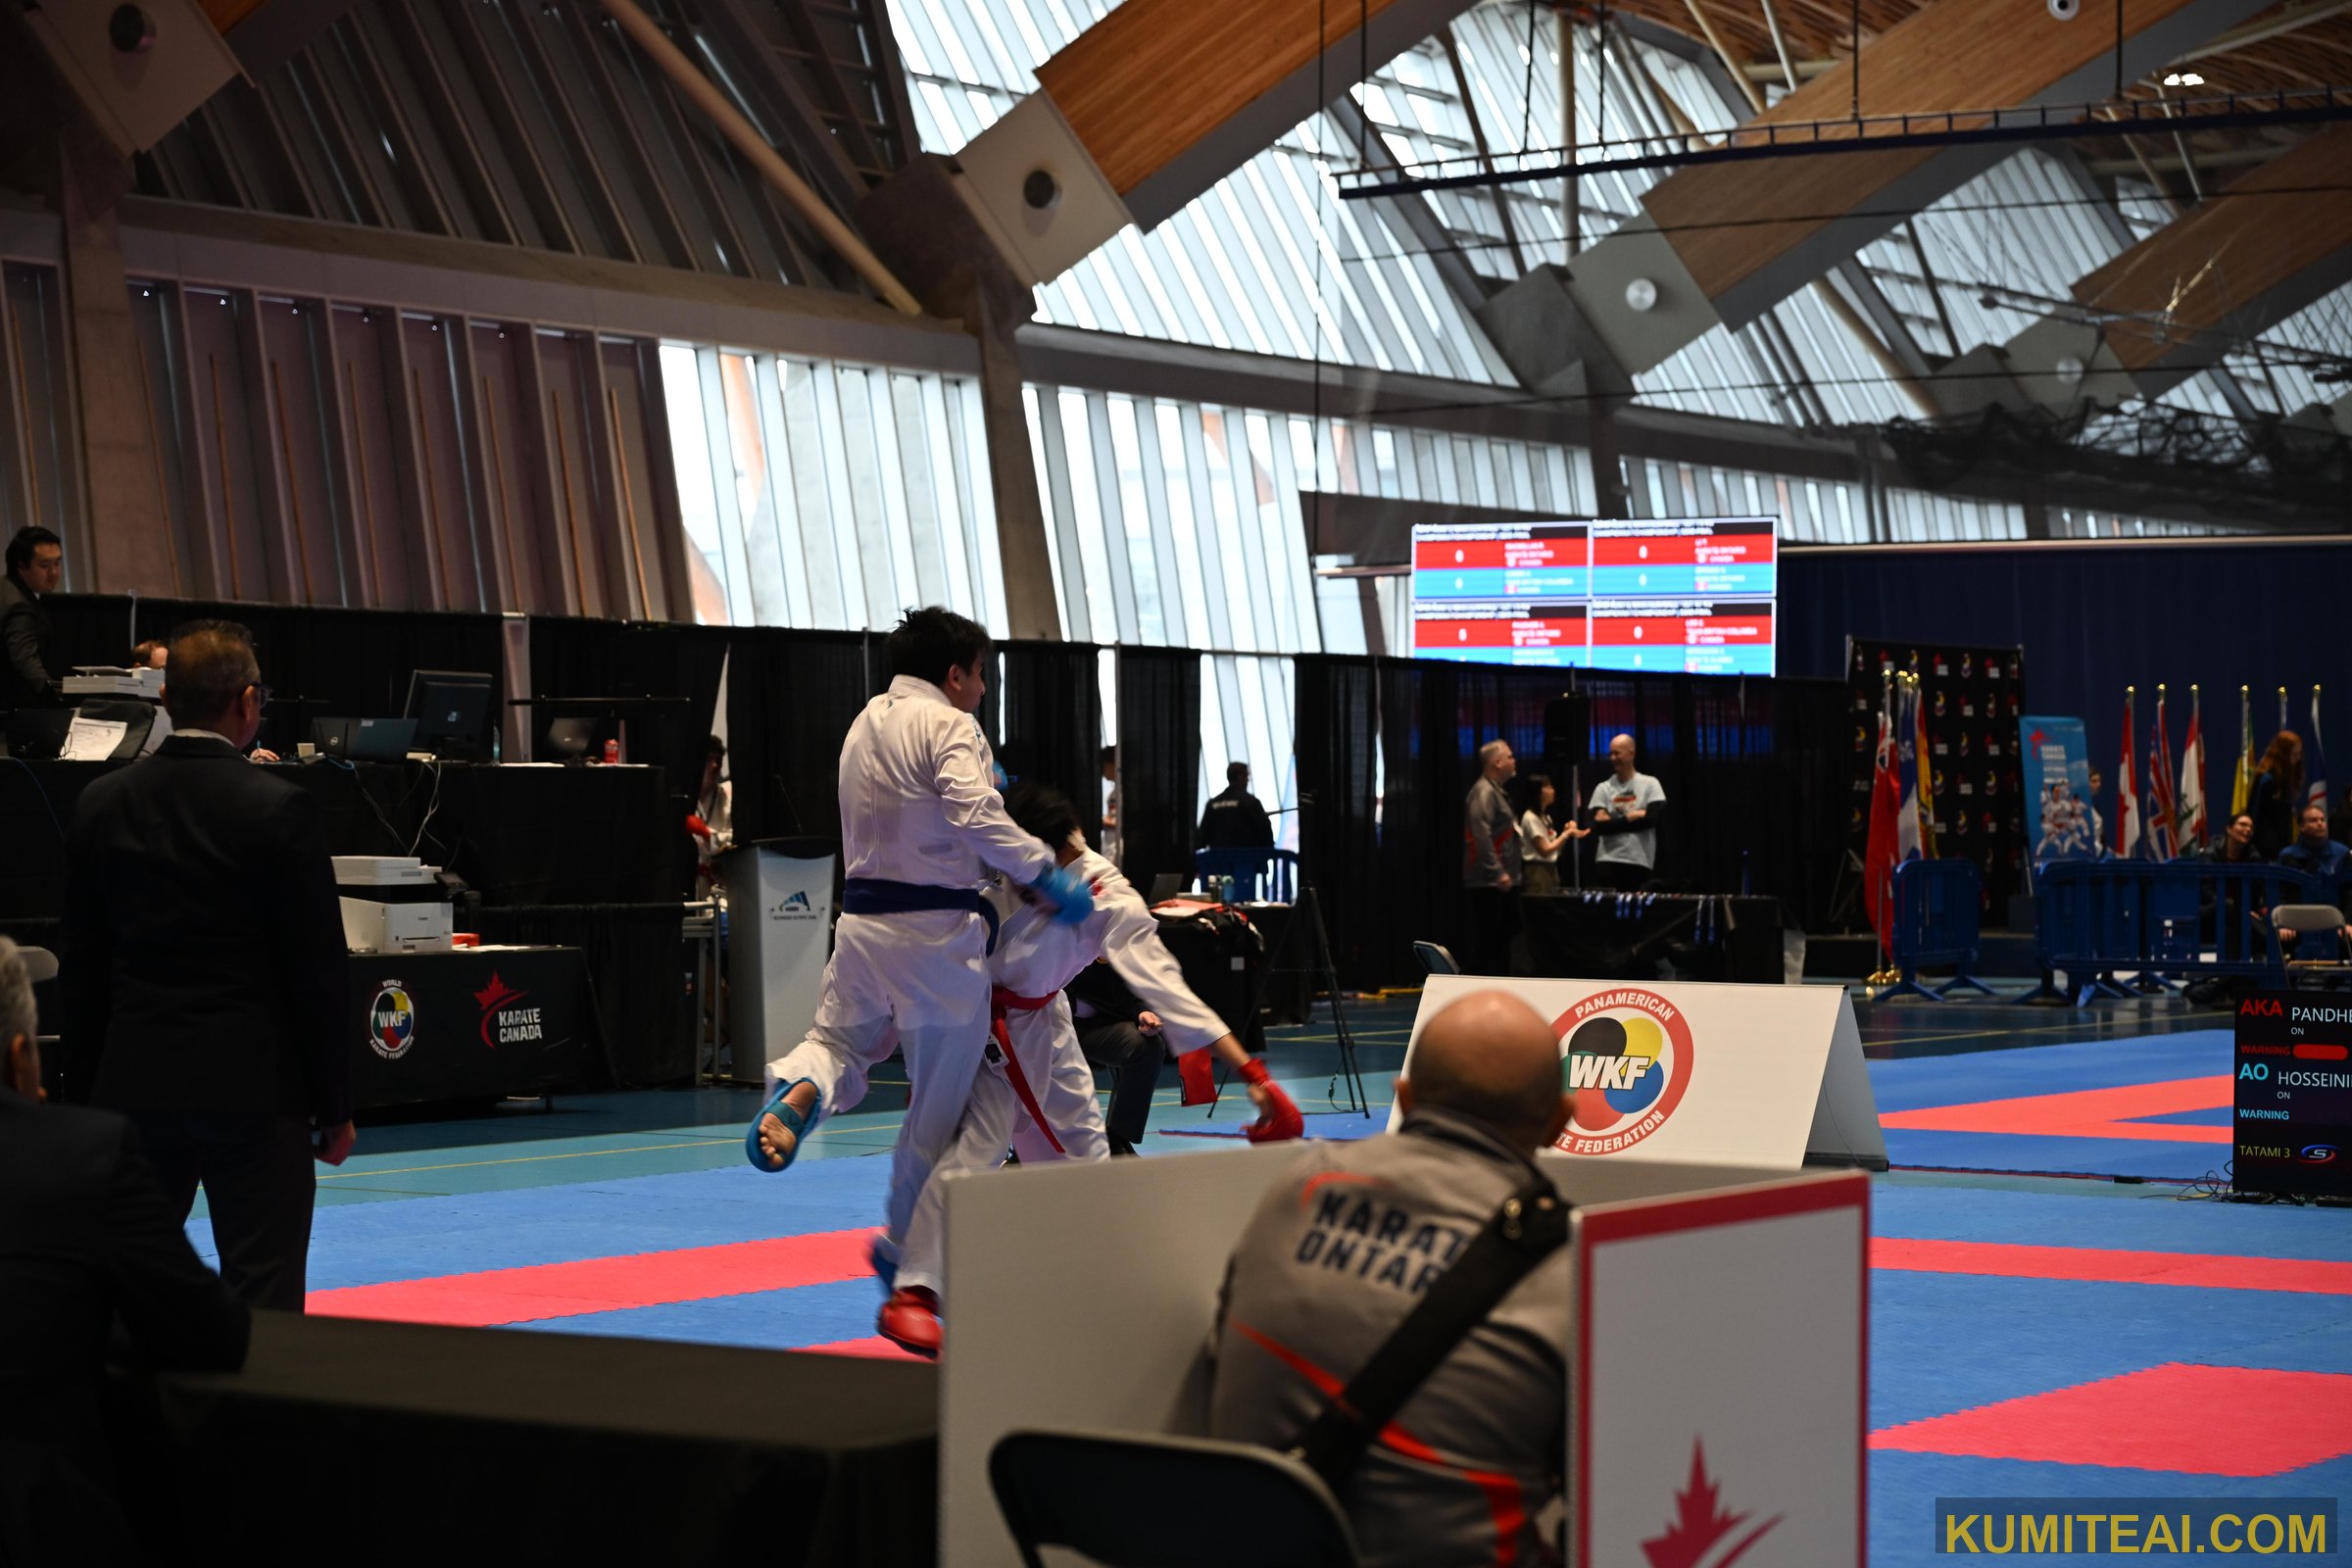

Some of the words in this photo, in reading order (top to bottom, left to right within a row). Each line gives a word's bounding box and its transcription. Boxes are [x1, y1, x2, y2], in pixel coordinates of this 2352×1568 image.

[381, 979, 403, 988] WORLD
[1574, 992, 1675, 1021] PANAMERICAN
[2240, 999, 2283, 1016] AKA
[377, 1010, 407, 1027] WKF
[499, 1007, 541, 1027] KARATE
[499, 1024, 543, 1043] CANADA
[2290, 1027, 2305, 1036] ON
[2240, 1044, 2290, 1056] WARNING
[1568, 1054, 1650, 1090] WKF
[2238, 1062, 2269, 1081] AO
[2278, 1071, 2352, 1088] HOSSEINI
[2277, 1091, 2290, 1100] ON
[2239, 1108, 2290, 1120] WARNING
[1574, 1109, 1665, 1153] FEDERATION
[2239, 1145, 2281, 1157] TATAMI
[2283, 1148, 2290, 1158] 3
[1316, 1190, 1467, 1262] KARAT
[1296, 1229, 1442, 1295] ONTAR
